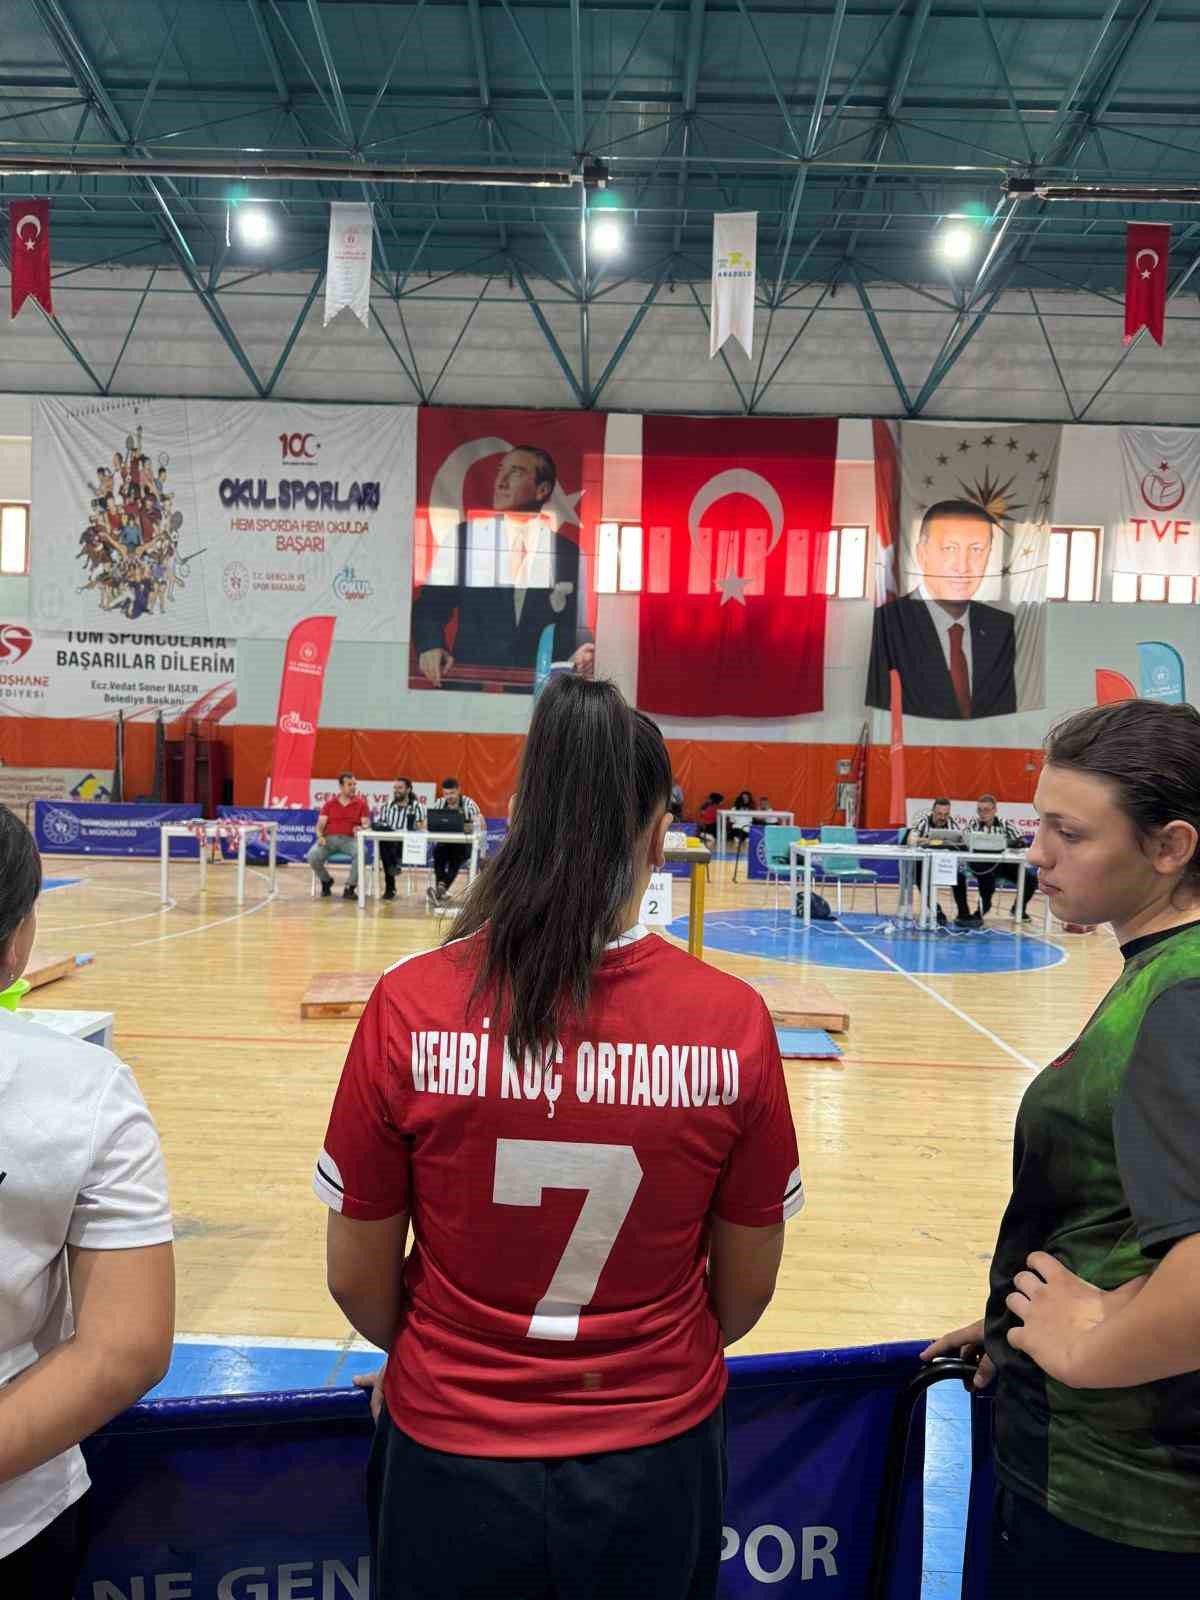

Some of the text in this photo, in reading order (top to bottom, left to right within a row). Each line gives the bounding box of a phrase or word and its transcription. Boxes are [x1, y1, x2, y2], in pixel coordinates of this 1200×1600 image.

[219, 478, 381, 511] OKUL SPORLARI
[230, 518, 369, 535] HEM SPORDA HEM OKULDA
[1129, 518, 1191, 545] TVF
[276, 536, 325, 555] BAŞARI
[56, 650, 235, 674] BAŞARILAR DİLERİM
[648, 900, 658, 915] 2
[410, 1017, 740, 1119] VEHBİ KOÇ ORTAOKULU
[492, 1138, 644, 1341] 7
